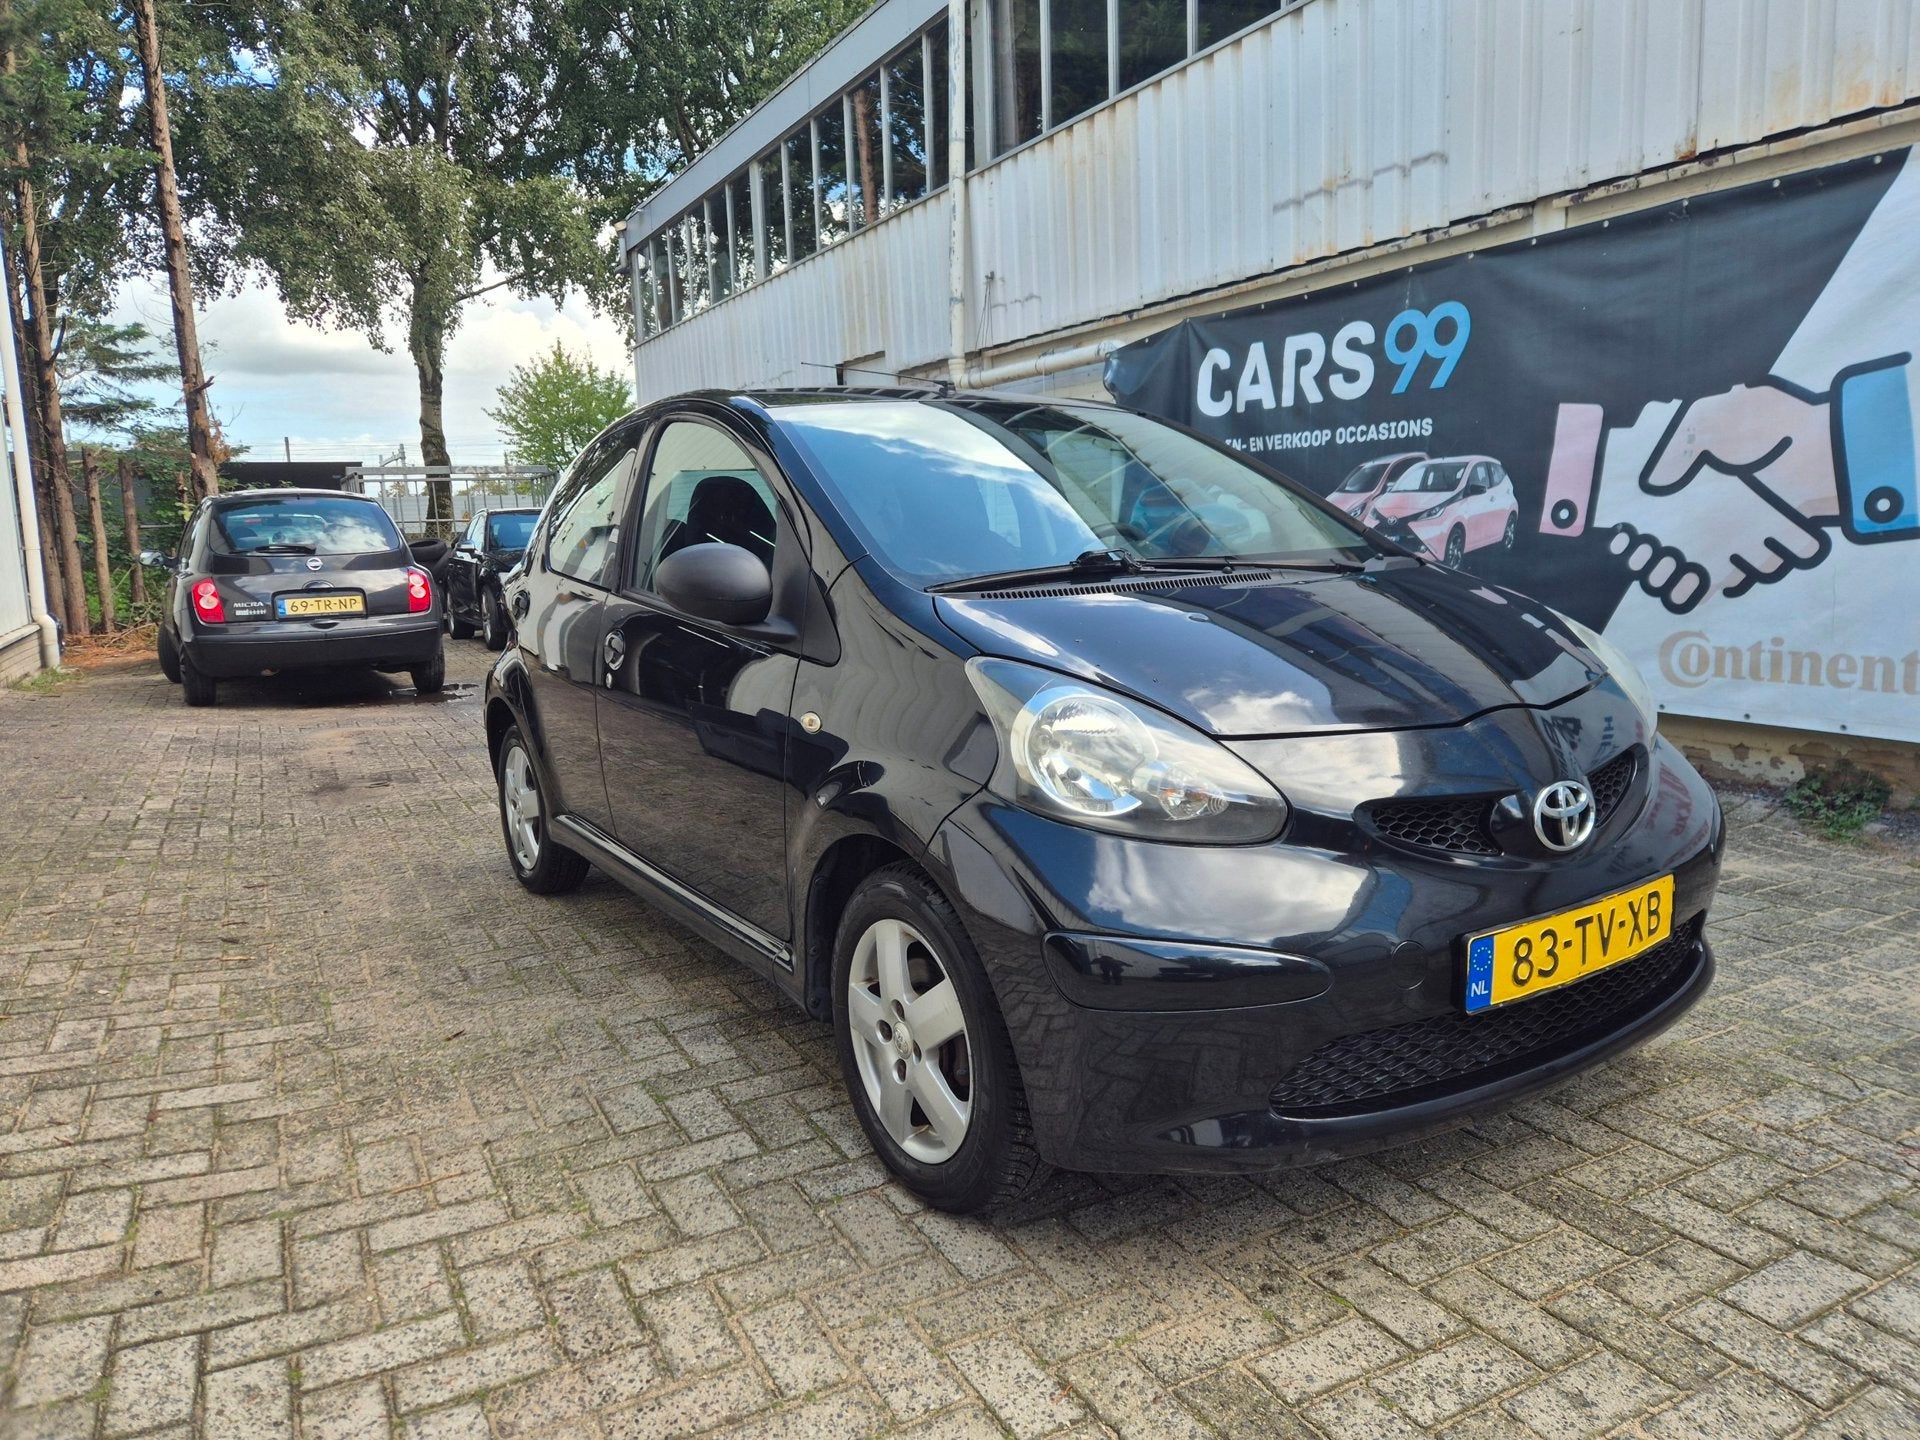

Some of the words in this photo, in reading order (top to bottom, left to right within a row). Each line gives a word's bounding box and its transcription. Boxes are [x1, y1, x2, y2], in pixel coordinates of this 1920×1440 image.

[1250, 436, 1264, 452] EN
[1266, 429, 1331, 451] VERKOOP
[1335, 418, 1433, 445] OCCASIONS
[290, 598, 358, 613] 69-TR-NP
[1512, 890, 1661, 987] 83-TV-XB
[1471, 980, 1489, 998] NL
